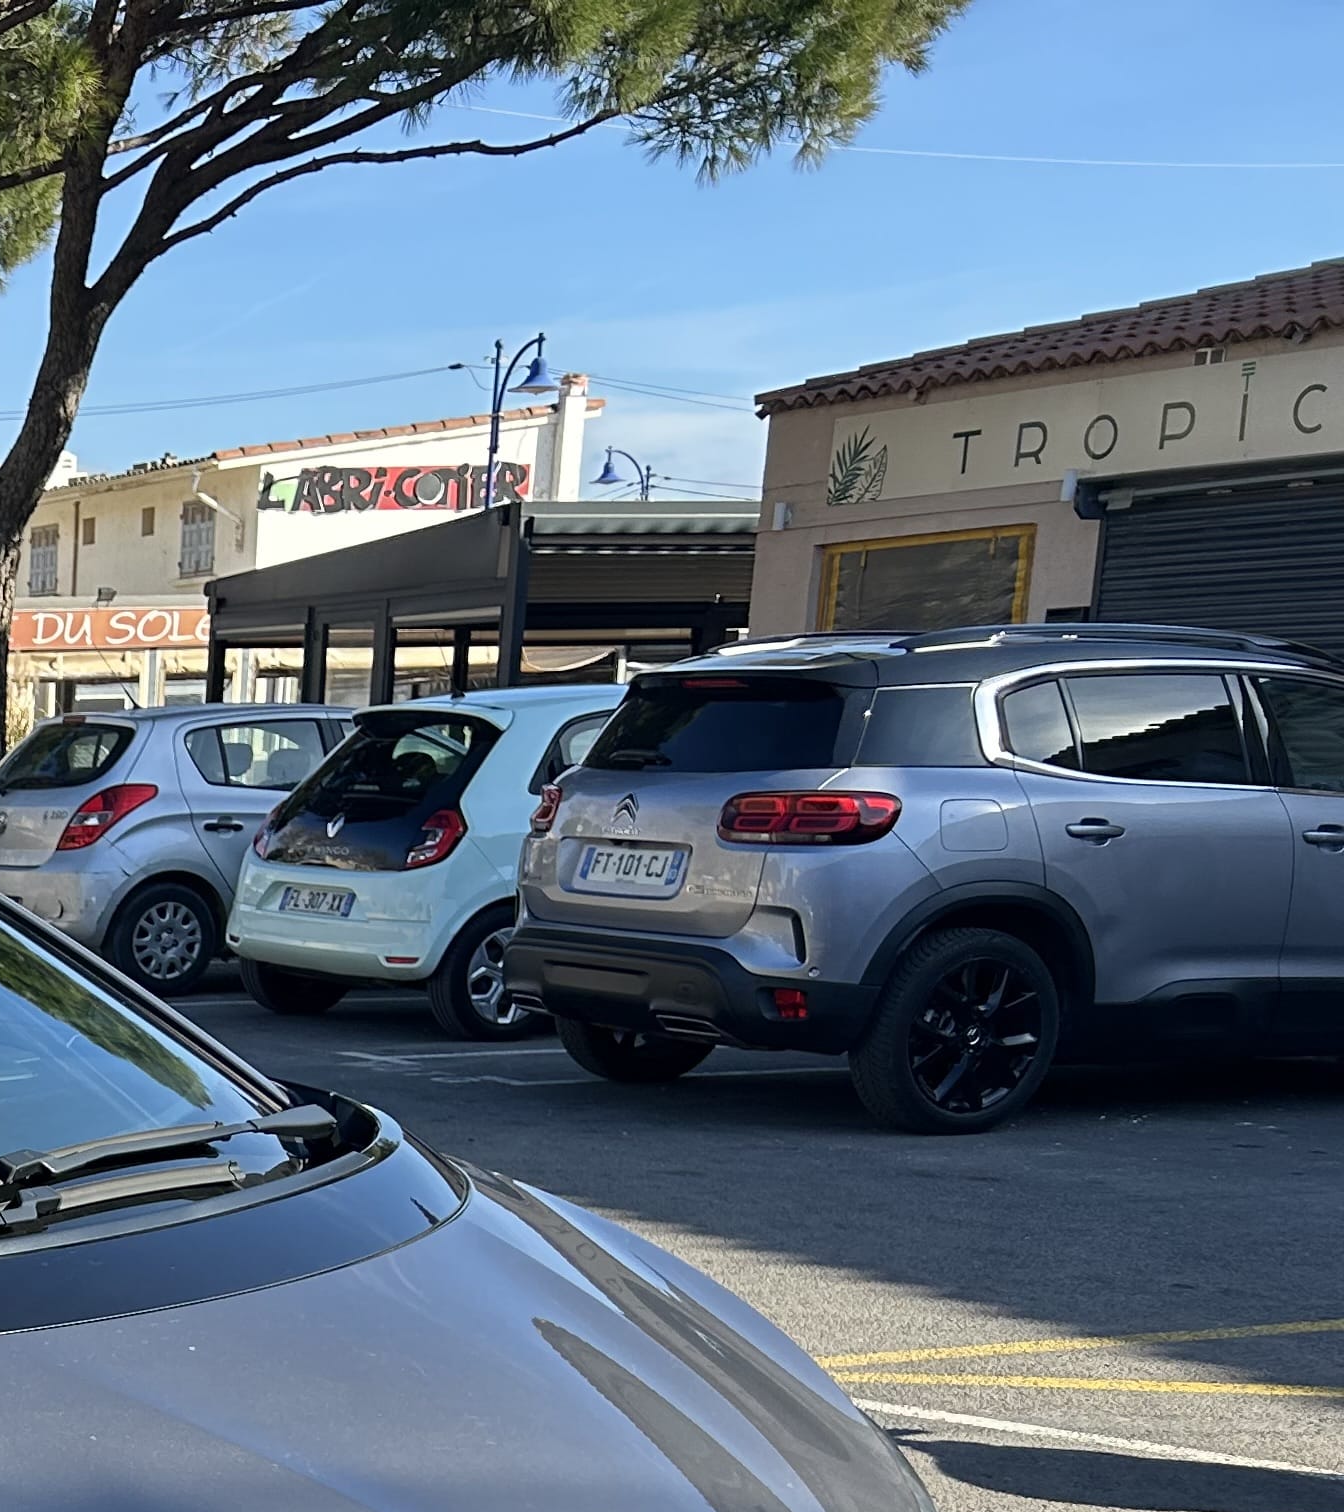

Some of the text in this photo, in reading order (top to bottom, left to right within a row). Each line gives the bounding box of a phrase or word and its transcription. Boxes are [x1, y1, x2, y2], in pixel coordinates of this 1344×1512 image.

[31, 612, 93, 645] DU
[105, 610, 211, 645] SOLE
[591, 852, 670, 878] FT-101-CJ
